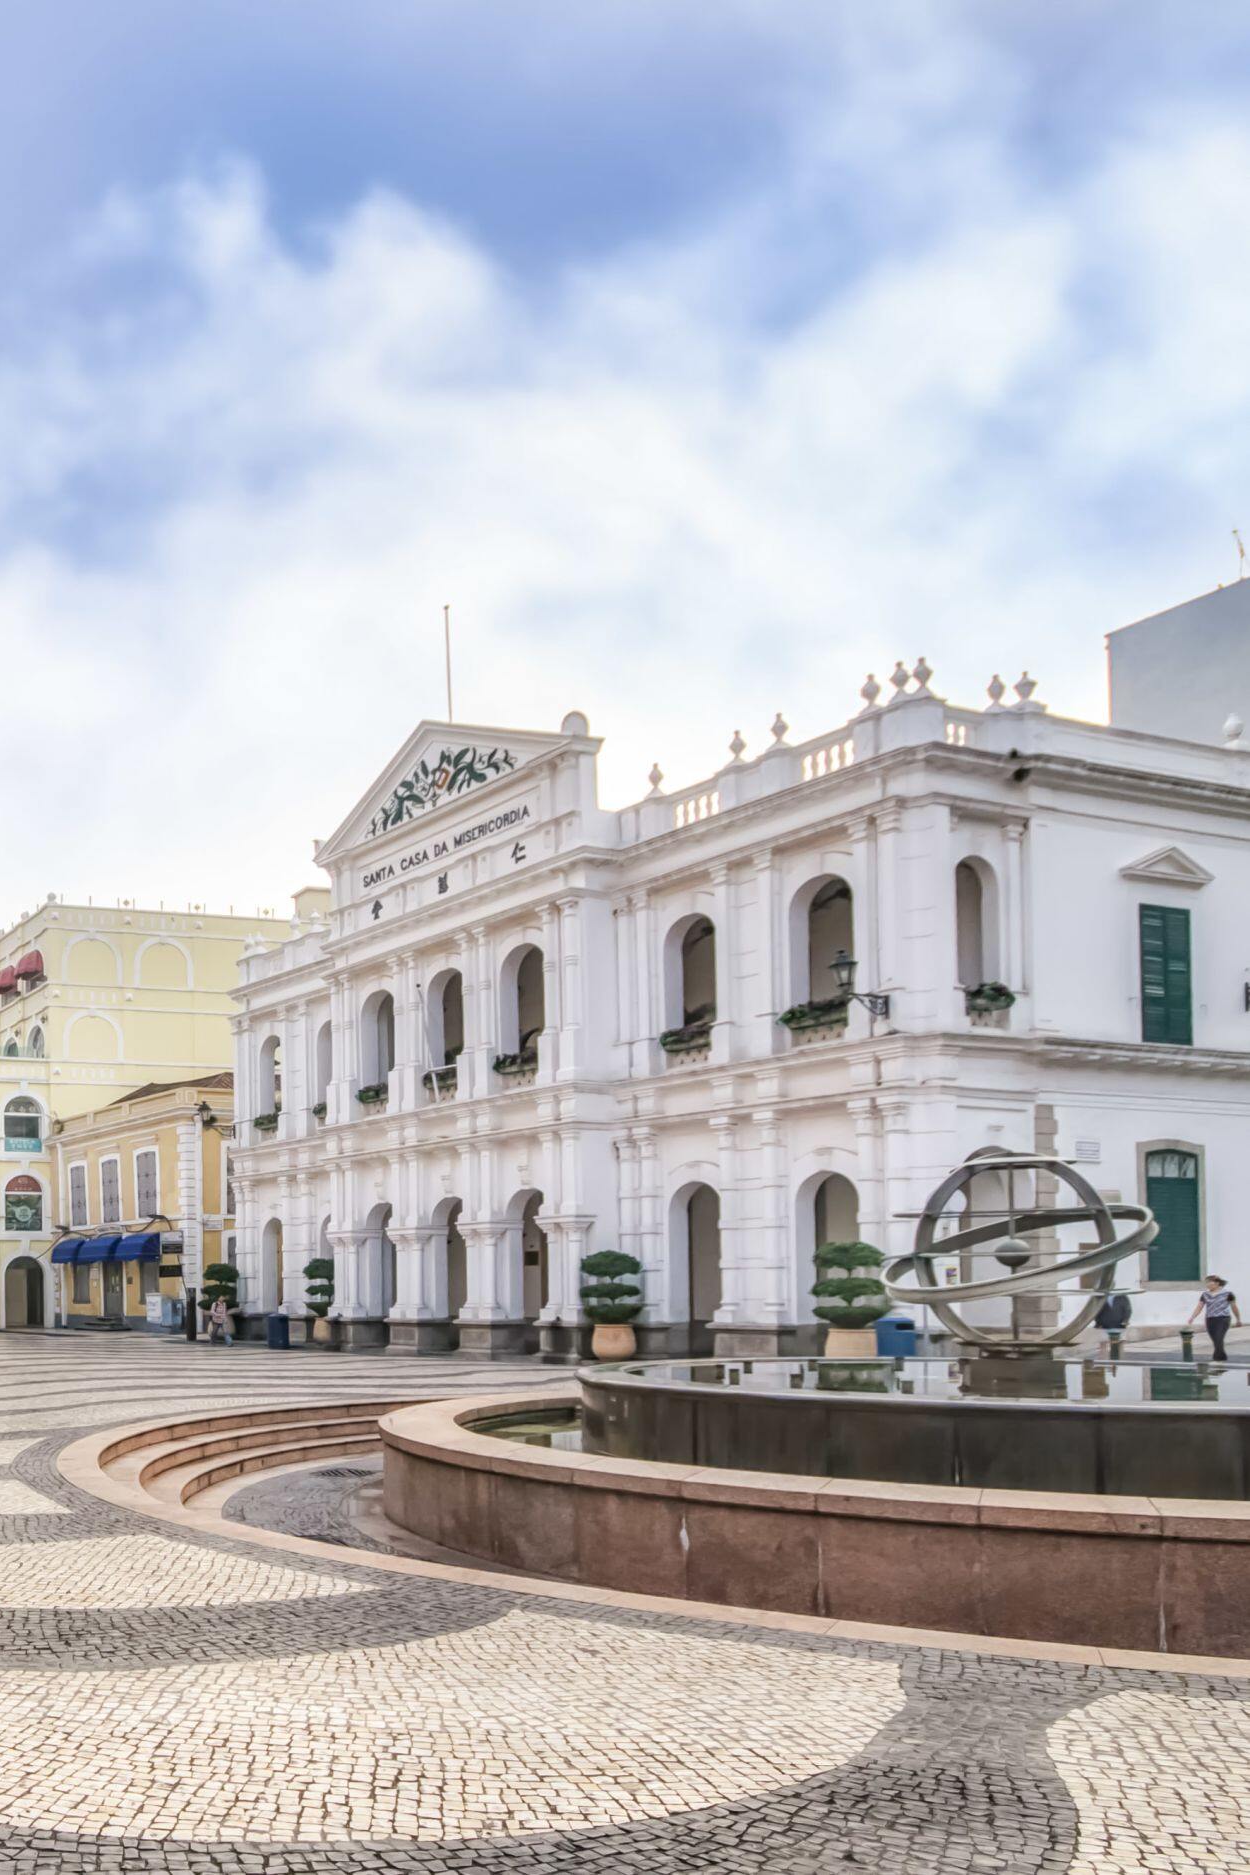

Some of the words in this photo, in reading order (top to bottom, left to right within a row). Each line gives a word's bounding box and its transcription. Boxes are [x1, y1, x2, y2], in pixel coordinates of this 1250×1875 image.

[363, 865, 395, 887] SANTA
[400, 850, 430, 871] CASA
[434, 840, 449, 858] DA
[454, 805, 530, 848] MISERICORDIA
